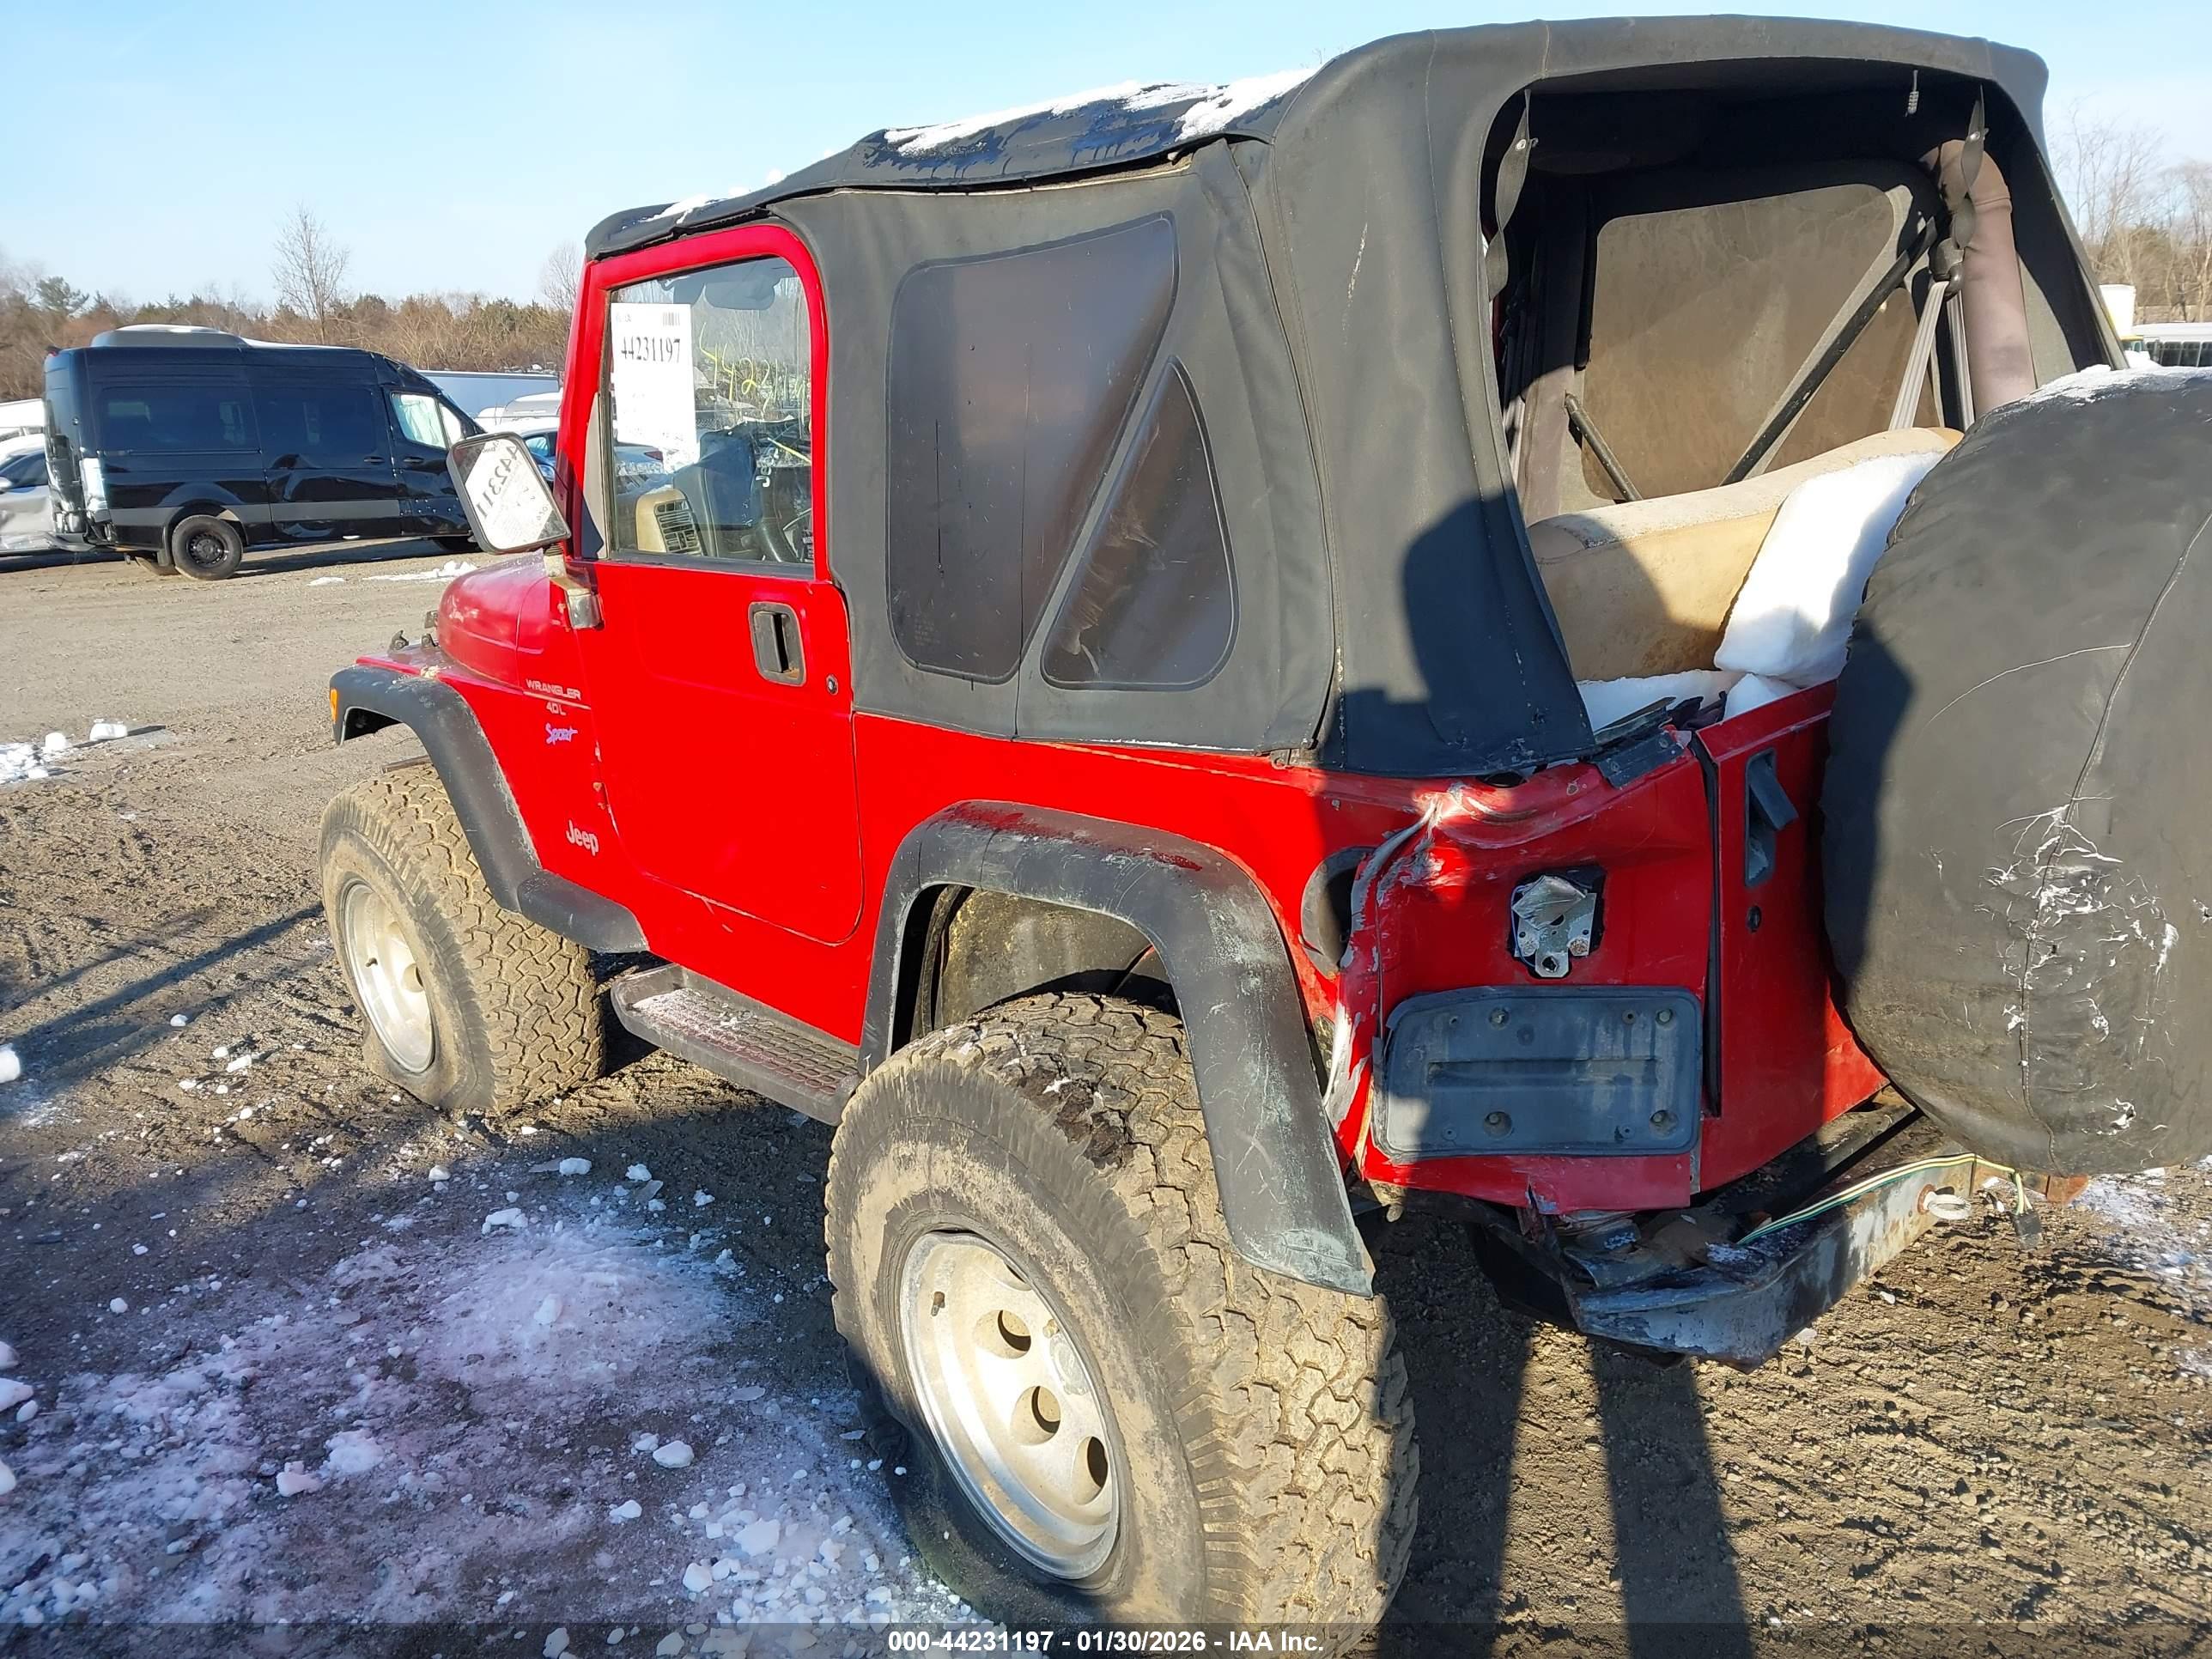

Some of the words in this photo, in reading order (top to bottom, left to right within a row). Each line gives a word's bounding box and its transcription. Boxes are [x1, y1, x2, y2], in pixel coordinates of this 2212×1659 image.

[621, 336, 681, 364] 44231197
[526, 678, 581, 701] WRANGLER
[565, 819, 599, 856] Jeep
